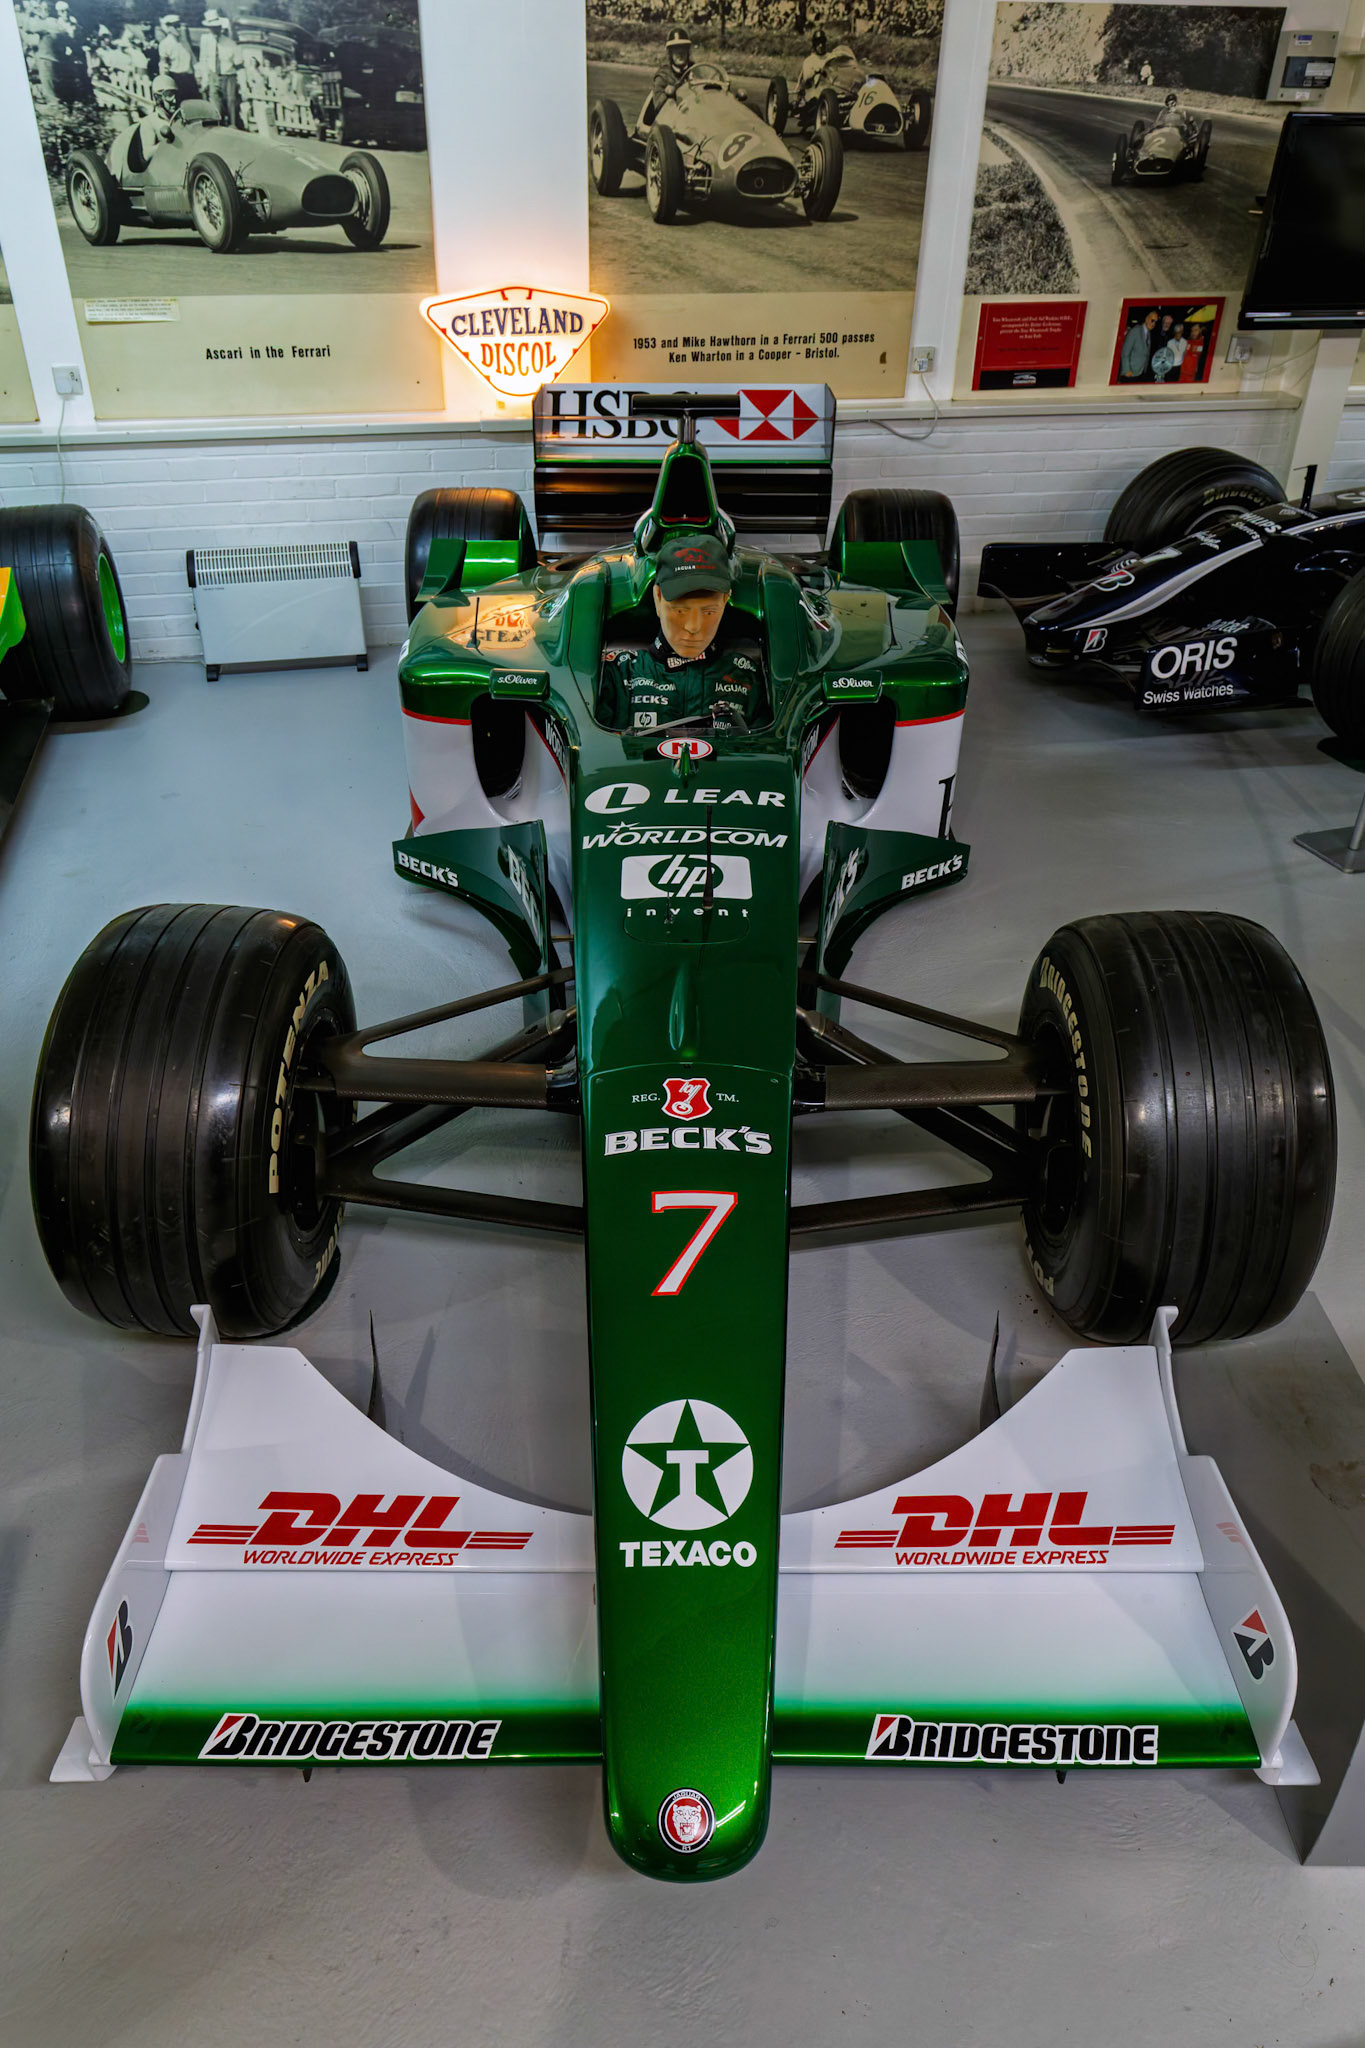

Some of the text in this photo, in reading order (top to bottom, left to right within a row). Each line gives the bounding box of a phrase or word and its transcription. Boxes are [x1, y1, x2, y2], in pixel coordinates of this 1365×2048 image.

[858, 91, 877, 108] 16
[722, 134, 752, 162] 8
[451, 307, 583, 336] CLEVELAND
[205, 345, 331, 360] Ascari in the Ferrari
[633, 333, 875, 349] 1953 and Mike Hawthorn in a Ferrari 500 passes
[669, 351, 687, 363] Ken
[691, 350, 732, 362] Wharton
[736, 350, 745, 361] in
[748, 352, 754, 361] a
[758, 349, 791, 362] Cooper
[805, 347, 840, 359] Bristol.
[480, 342, 556, 376] DISCOL
[1150, 636, 1237, 679] ORIS
[497, 674, 538, 685] s.Oliver
[715, 683, 748, 696] JAGUAR
[832, 677, 874, 689] s.Oliver
[1143, 683, 1234, 705] Swiss Watches
[663, 788, 786, 808] LEAR
[581, 829, 788, 850] WORLDCOM
[397, 849, 459, 888] BECK'S
[657, 854, 716, 898] hp
[900, 854, 963, 891] BECK'S
[1039, 956, 1092, 1160] BRIDGESTONE
[268, 959, 329, 1194] POTENZA
[631, 1092, 739, 1103] REG. TM.
[603, 1125, 773, 1156] BECK'S
[651, 1189, 738, 1296] 7
[247, 1491, 473, 1549] DHL
[891, 1491, 1114, 1549] DHL
[243, 1549, 460, 1567] WORLDWIDE EXPRESS
[619, 1540, 758, 1568] TEXACO
[895, 1549, 1110, 1566] WORLDWIDE EXPRESS
[197, 1712, 503, 1761] BRIDGESTONE
[864, 1713, 1159, 1765] BRIDGESTONE
[672, 1791, 701, 1801] JAGUAR
